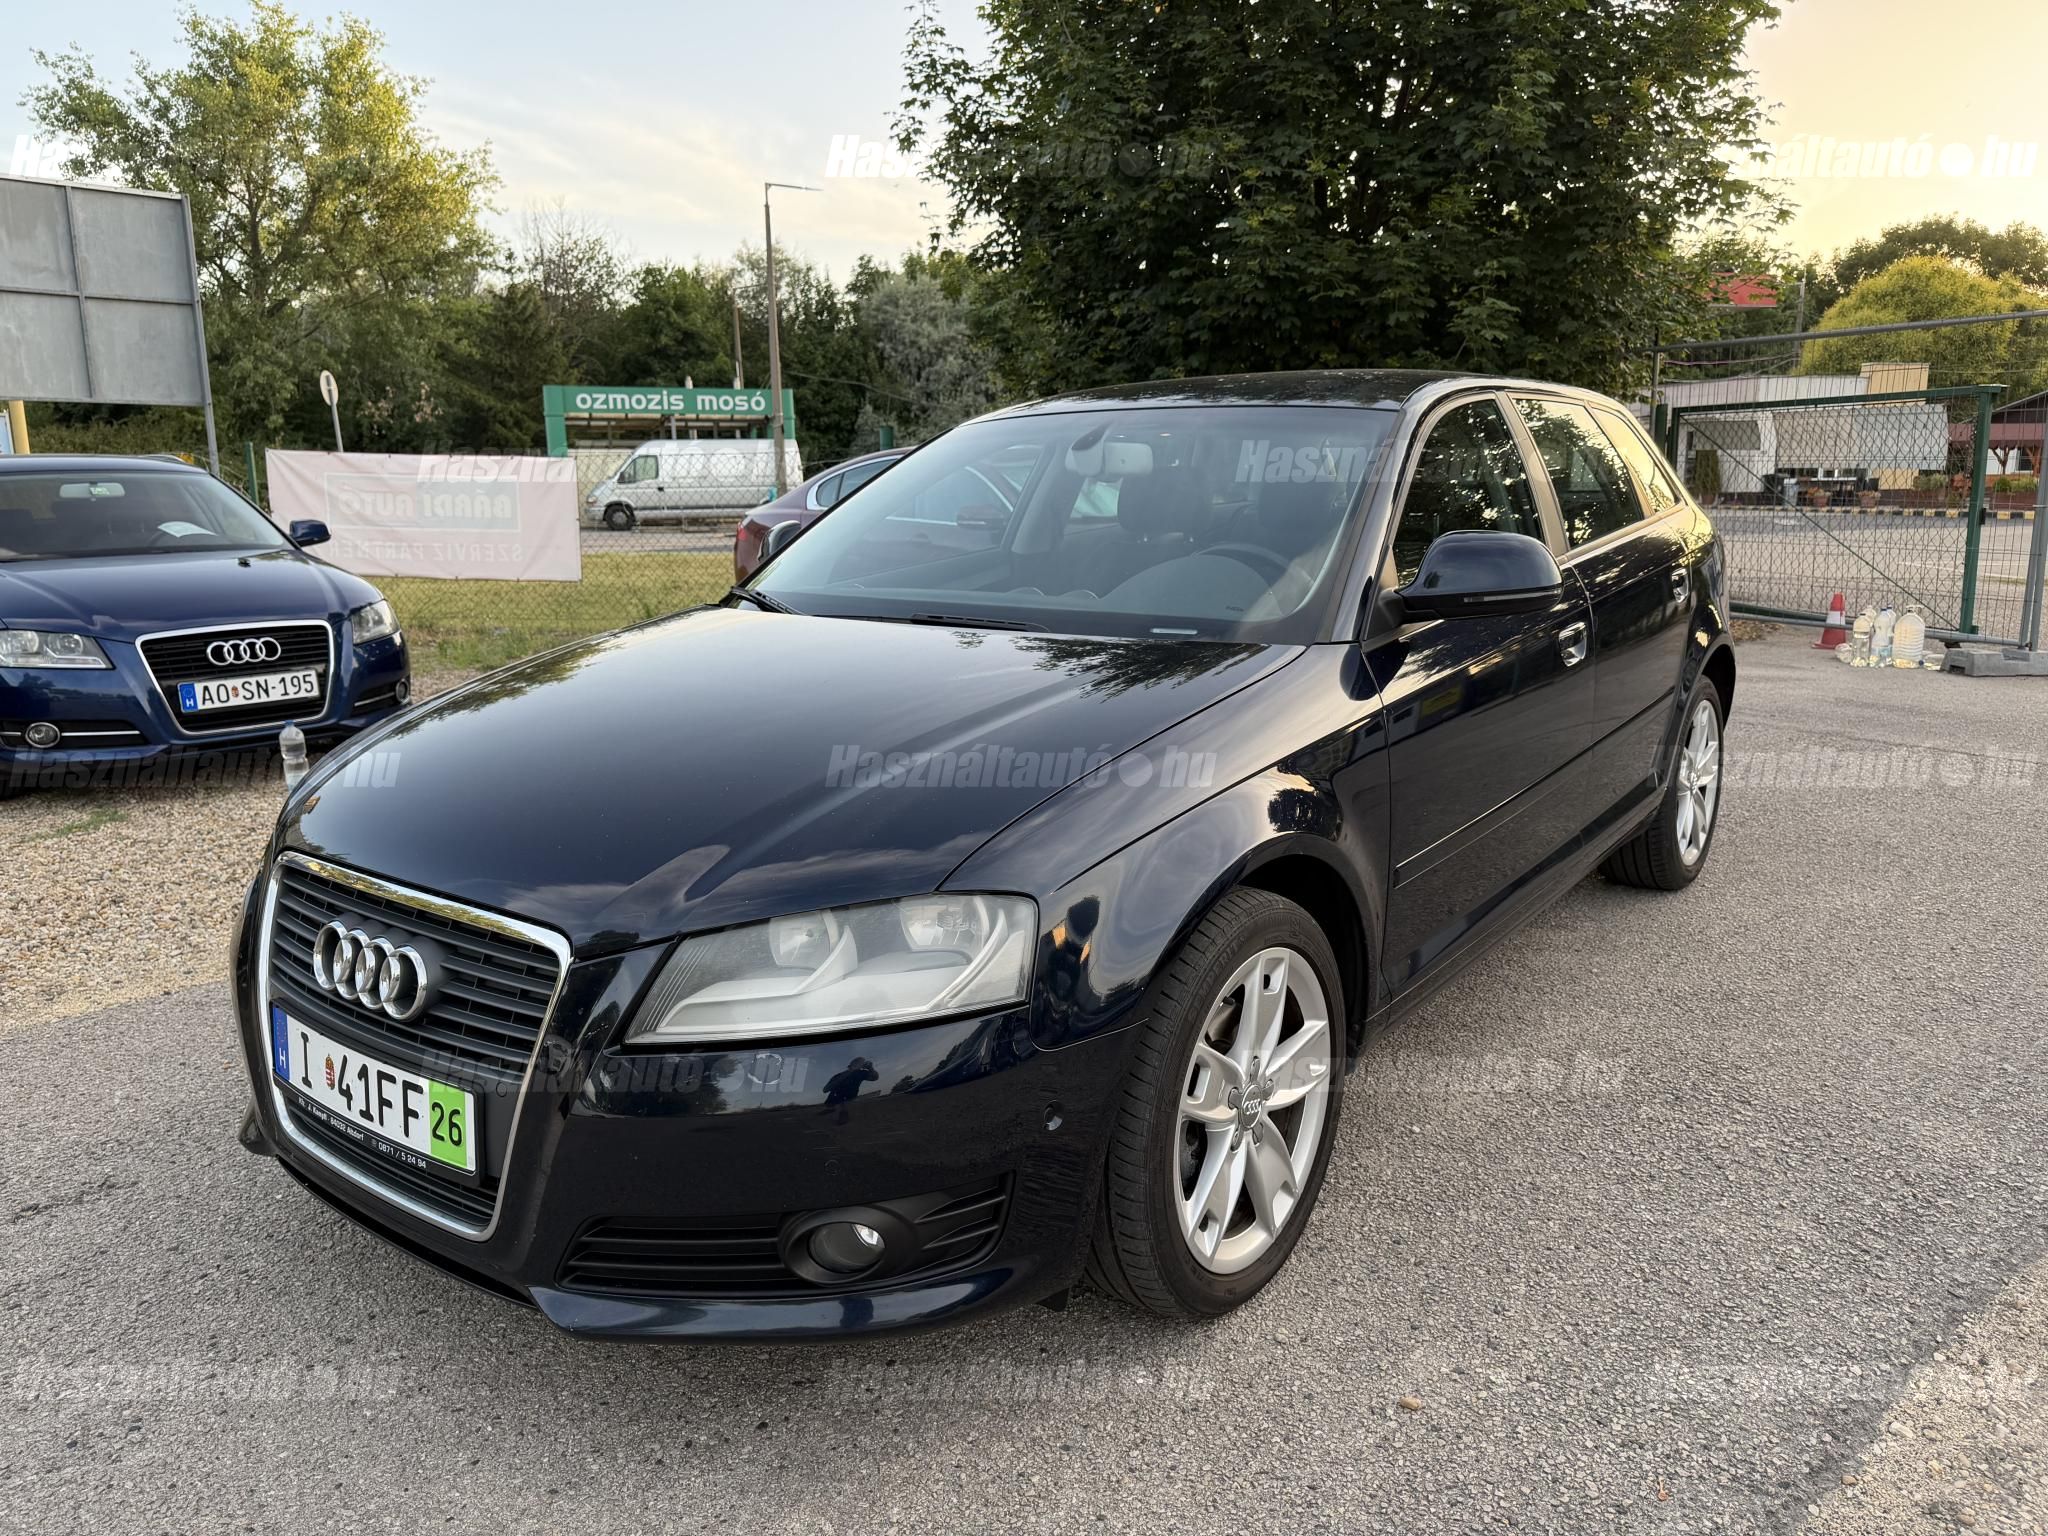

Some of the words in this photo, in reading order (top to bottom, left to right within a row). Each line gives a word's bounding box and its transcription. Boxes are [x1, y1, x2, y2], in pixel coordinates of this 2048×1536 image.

[576, 390, 685, 411] ozmozis
[697, 392, 766, 412] mosó
[186, 698, 194, 707] H
[279, 1047, 287, 1068] H
[337, 1054, 424, 1139] 41FF
[431, 1101, 463, 1147] 26
[378, 1142, 394, 1155] 0871
[407, 1155, 416, 1164] 24
